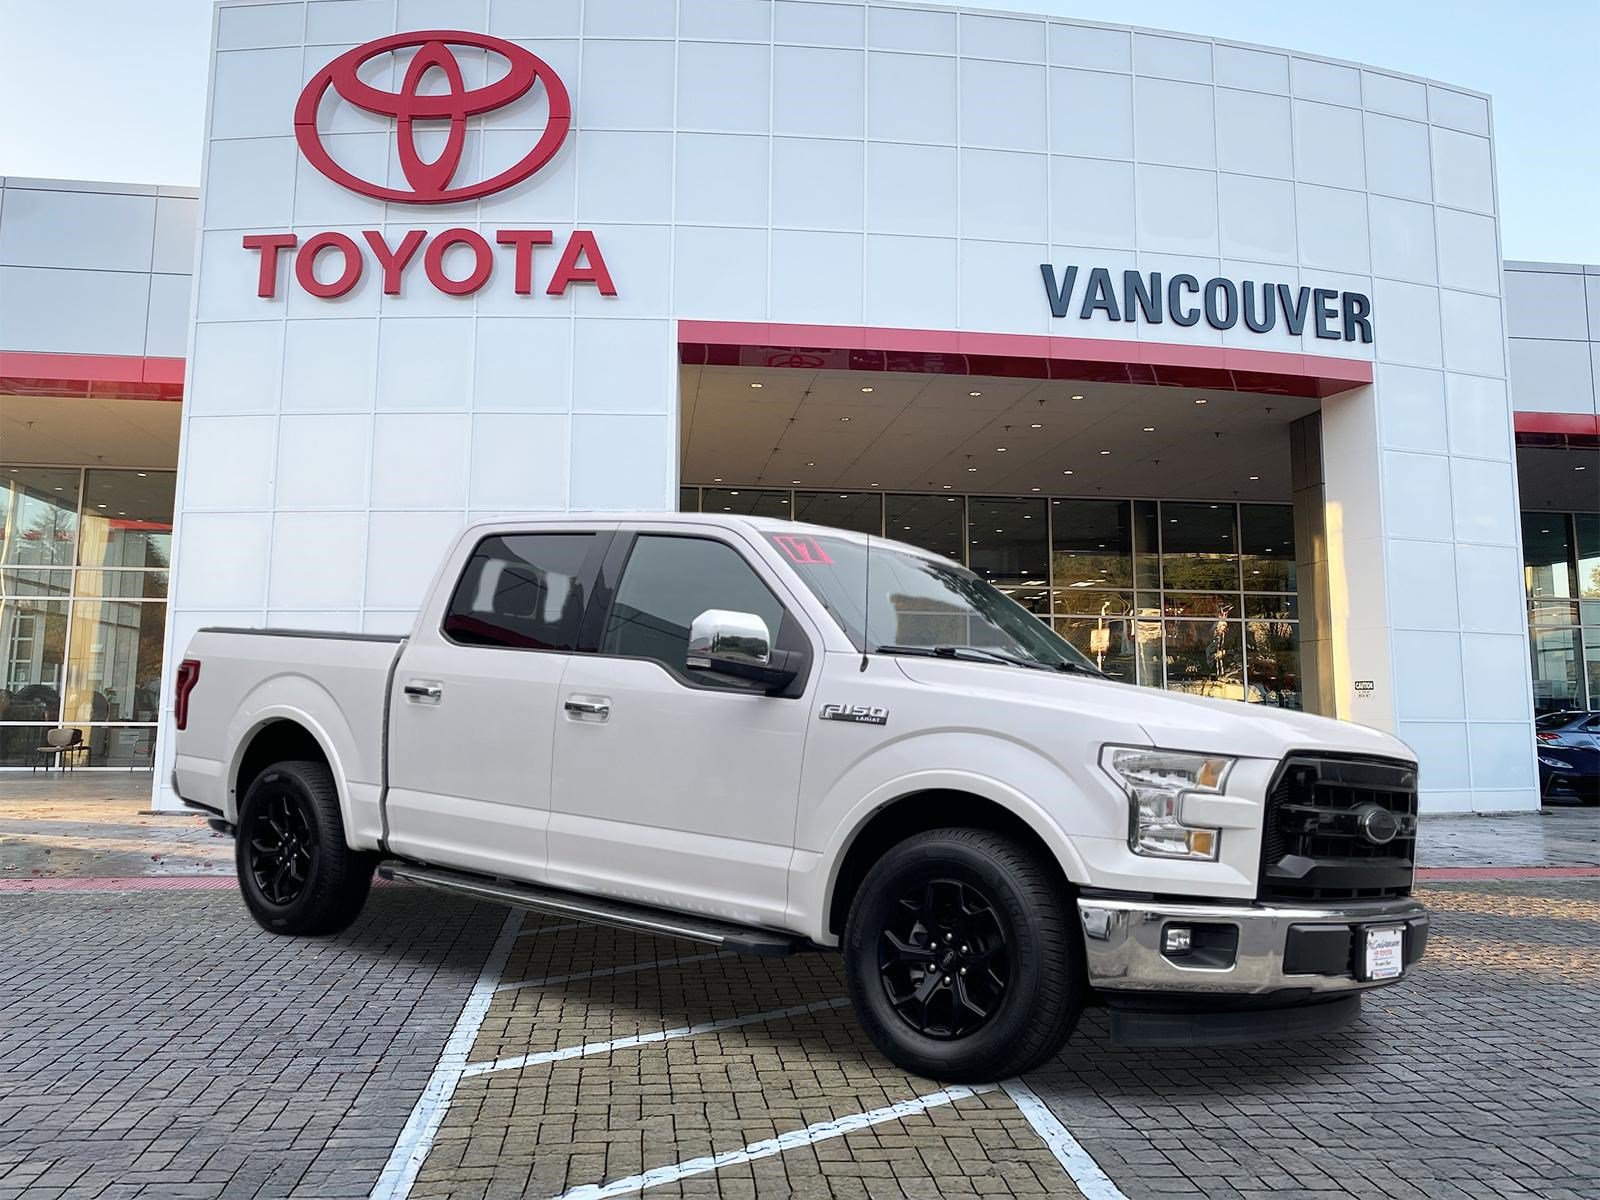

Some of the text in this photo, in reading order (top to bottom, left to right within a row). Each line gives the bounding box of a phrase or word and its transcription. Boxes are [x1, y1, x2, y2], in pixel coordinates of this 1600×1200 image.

[243, 228, 618, 298] TOYOTA
[1040, 264, 1373, 343] VANCOUVER
[855, 715, 881, 723] LARIAT
